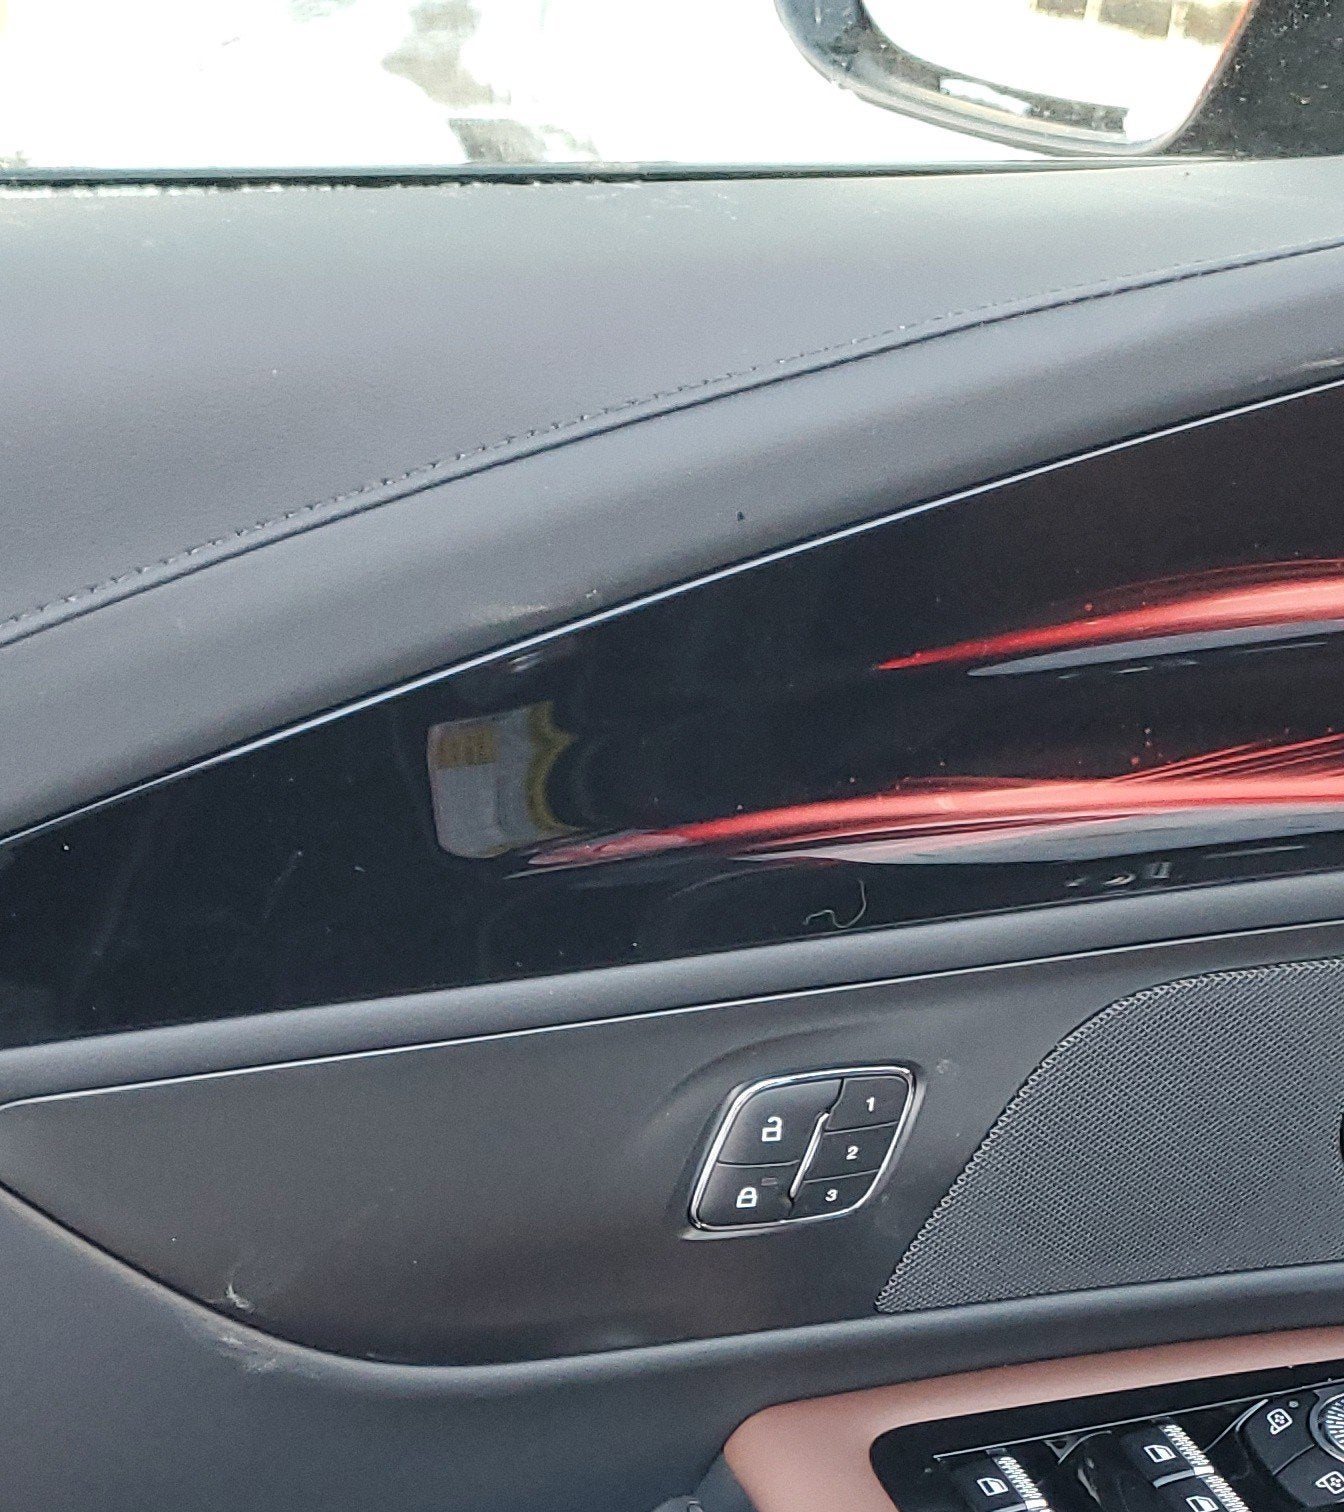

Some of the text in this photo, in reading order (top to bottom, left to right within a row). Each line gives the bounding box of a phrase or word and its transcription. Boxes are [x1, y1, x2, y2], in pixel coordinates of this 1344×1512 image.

[865, 1096, 876, 1112] 1
[845, 1145, 859, 1160] 2
[825, 1188, 839, 1202] 3
